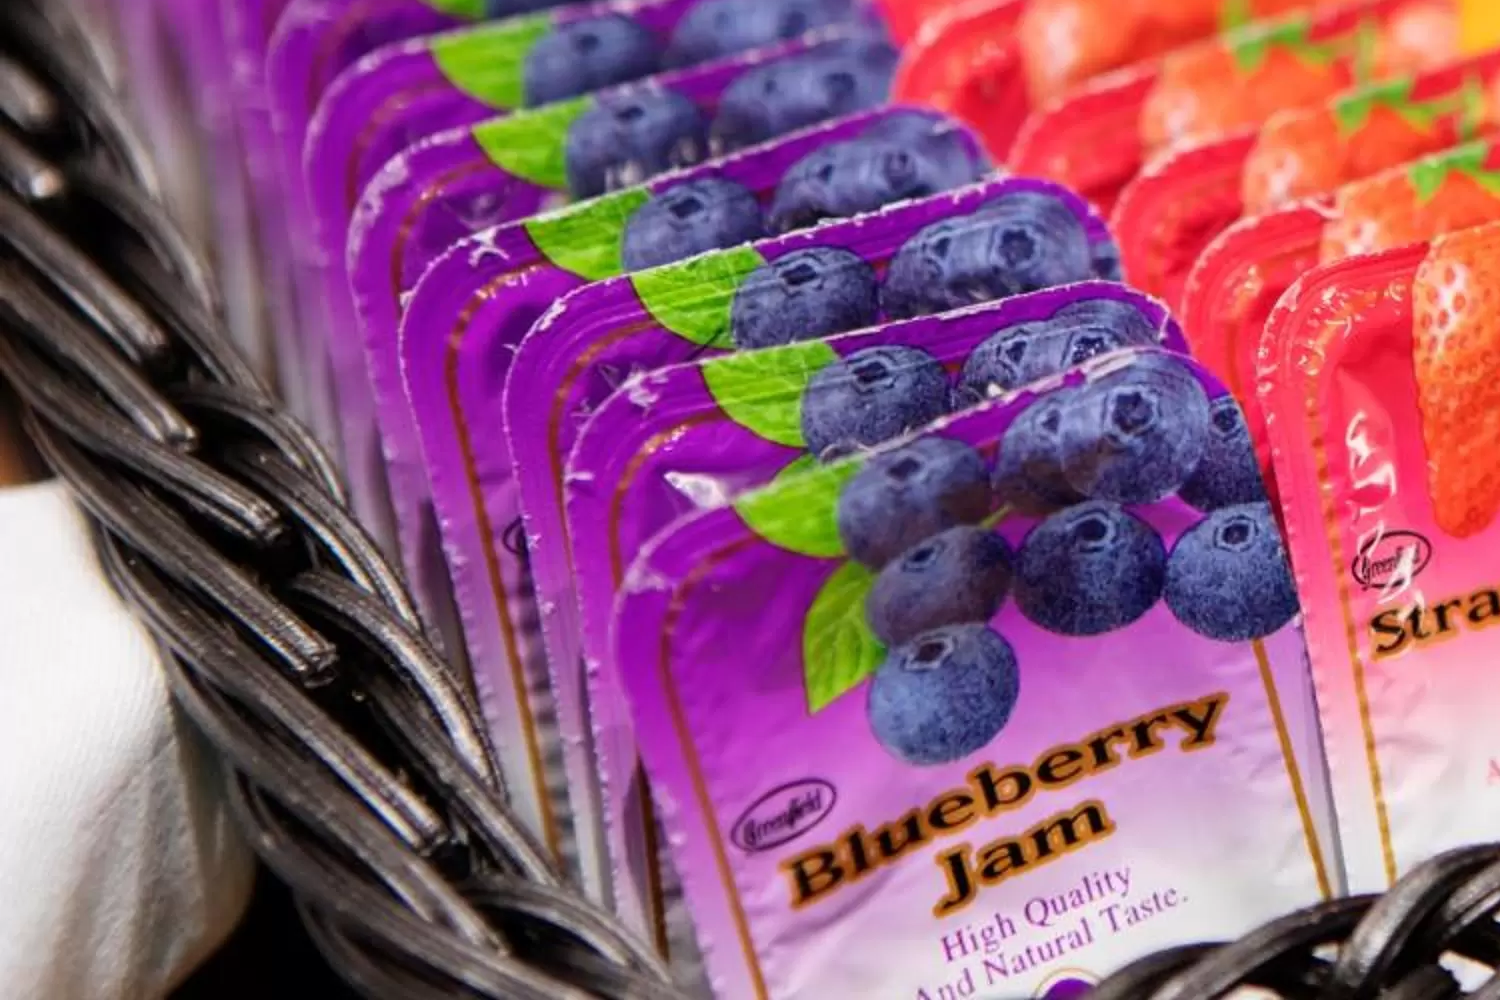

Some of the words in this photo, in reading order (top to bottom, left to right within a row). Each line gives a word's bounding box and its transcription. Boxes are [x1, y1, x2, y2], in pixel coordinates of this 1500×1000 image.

[781, 693, 1229, 908] Blueberry
[934, 799, 1116, 917] Jam
[941, 912, 1018, 963] High
[1024, 866, 1132, 927] Quality
[982, 917, 1094, 985] Natural
